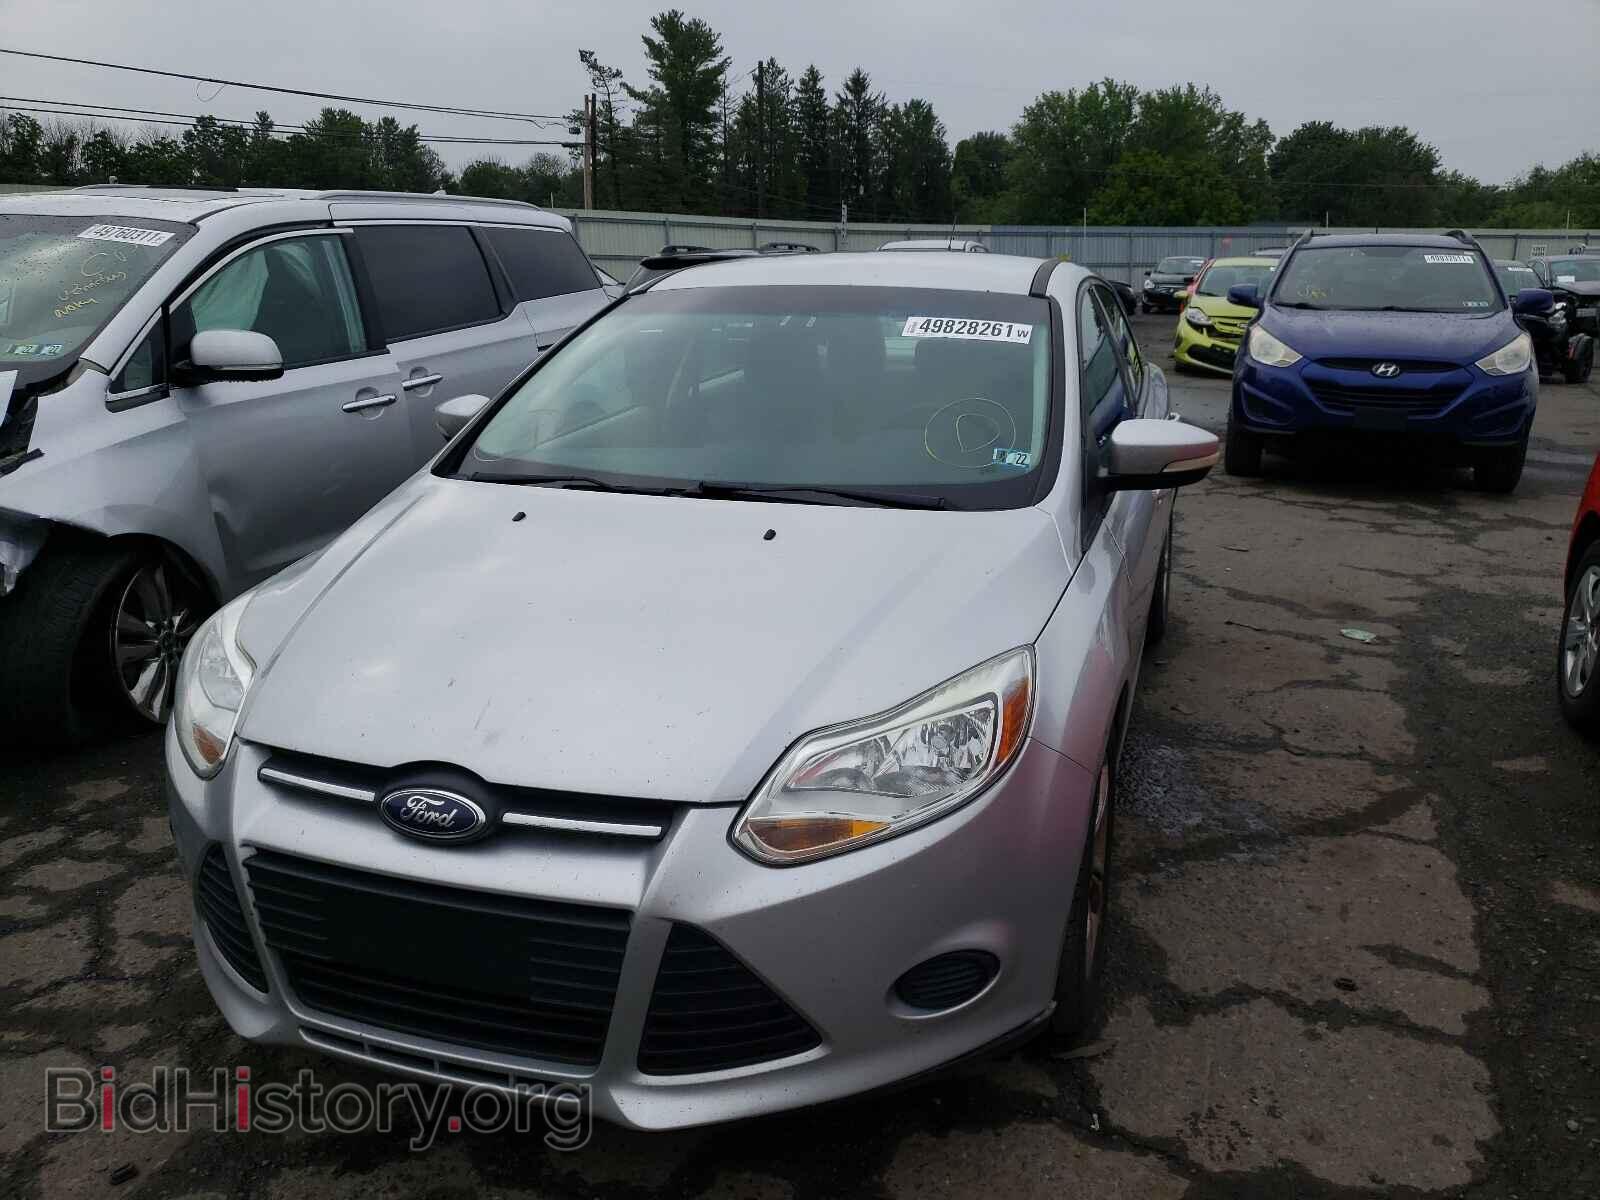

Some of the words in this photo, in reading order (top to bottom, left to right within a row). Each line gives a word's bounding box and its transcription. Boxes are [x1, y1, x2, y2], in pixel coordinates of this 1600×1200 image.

[920, 319, 1013, 337] 49828261
[1016, 453, 1027, 464] 22
[401, 796, 458, 828] Ford
